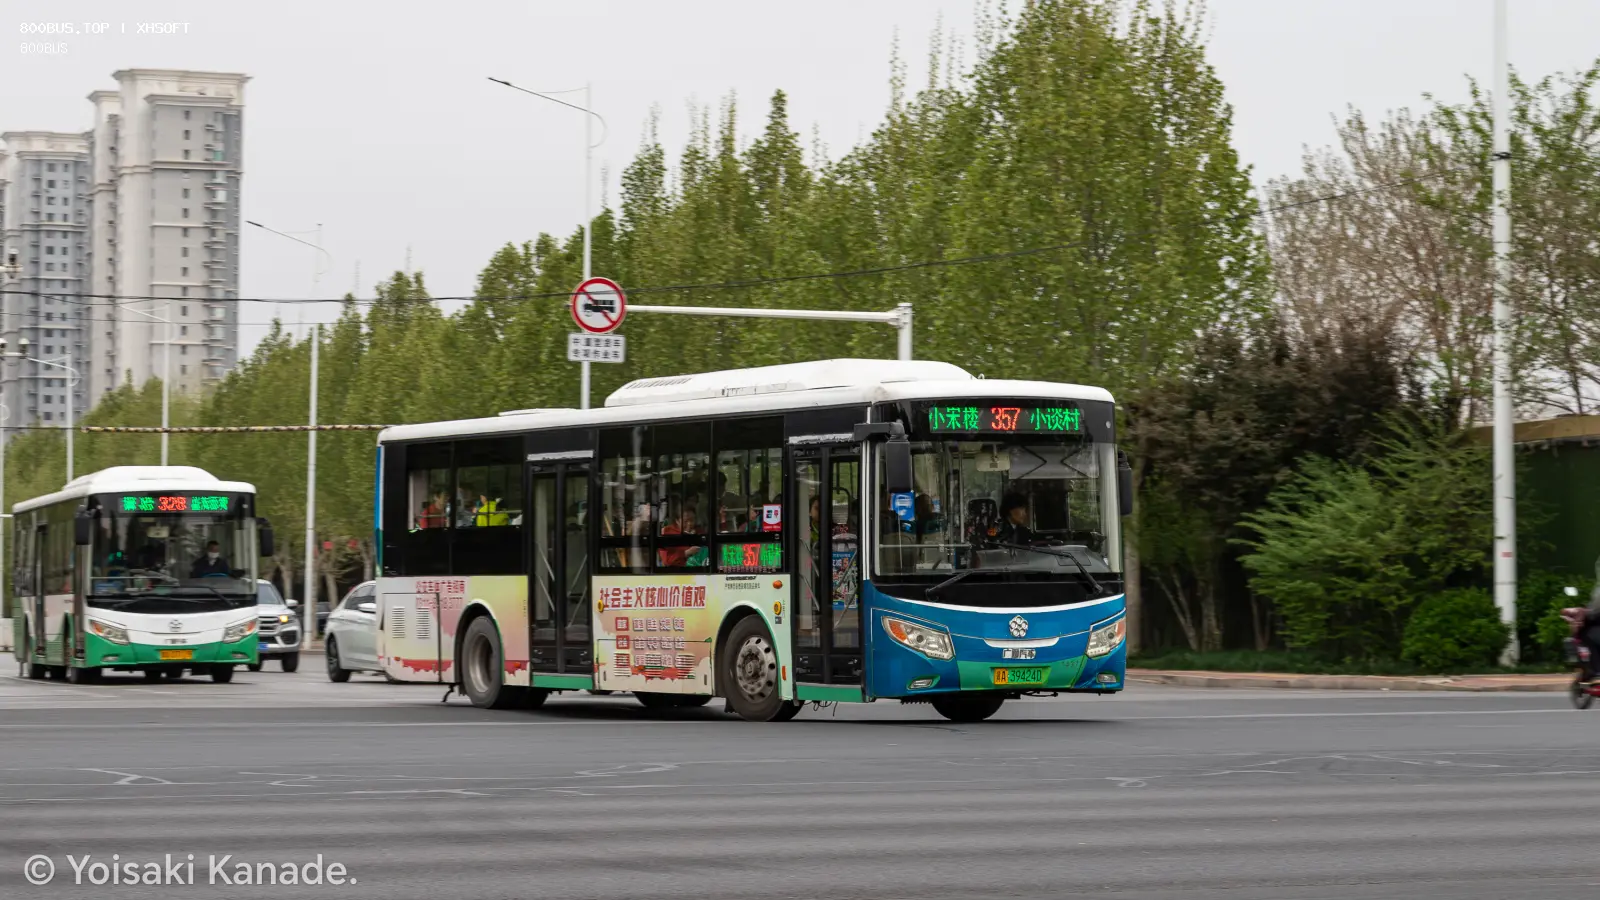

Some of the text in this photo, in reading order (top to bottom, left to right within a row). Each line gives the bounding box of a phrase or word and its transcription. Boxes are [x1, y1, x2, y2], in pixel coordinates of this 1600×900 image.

[929, 407, 1080, 431] 小宋楼 357 小谈村
[743, 544, 761, 567] 357
[600, 585, 706, 608] 社会主义核心价值观
